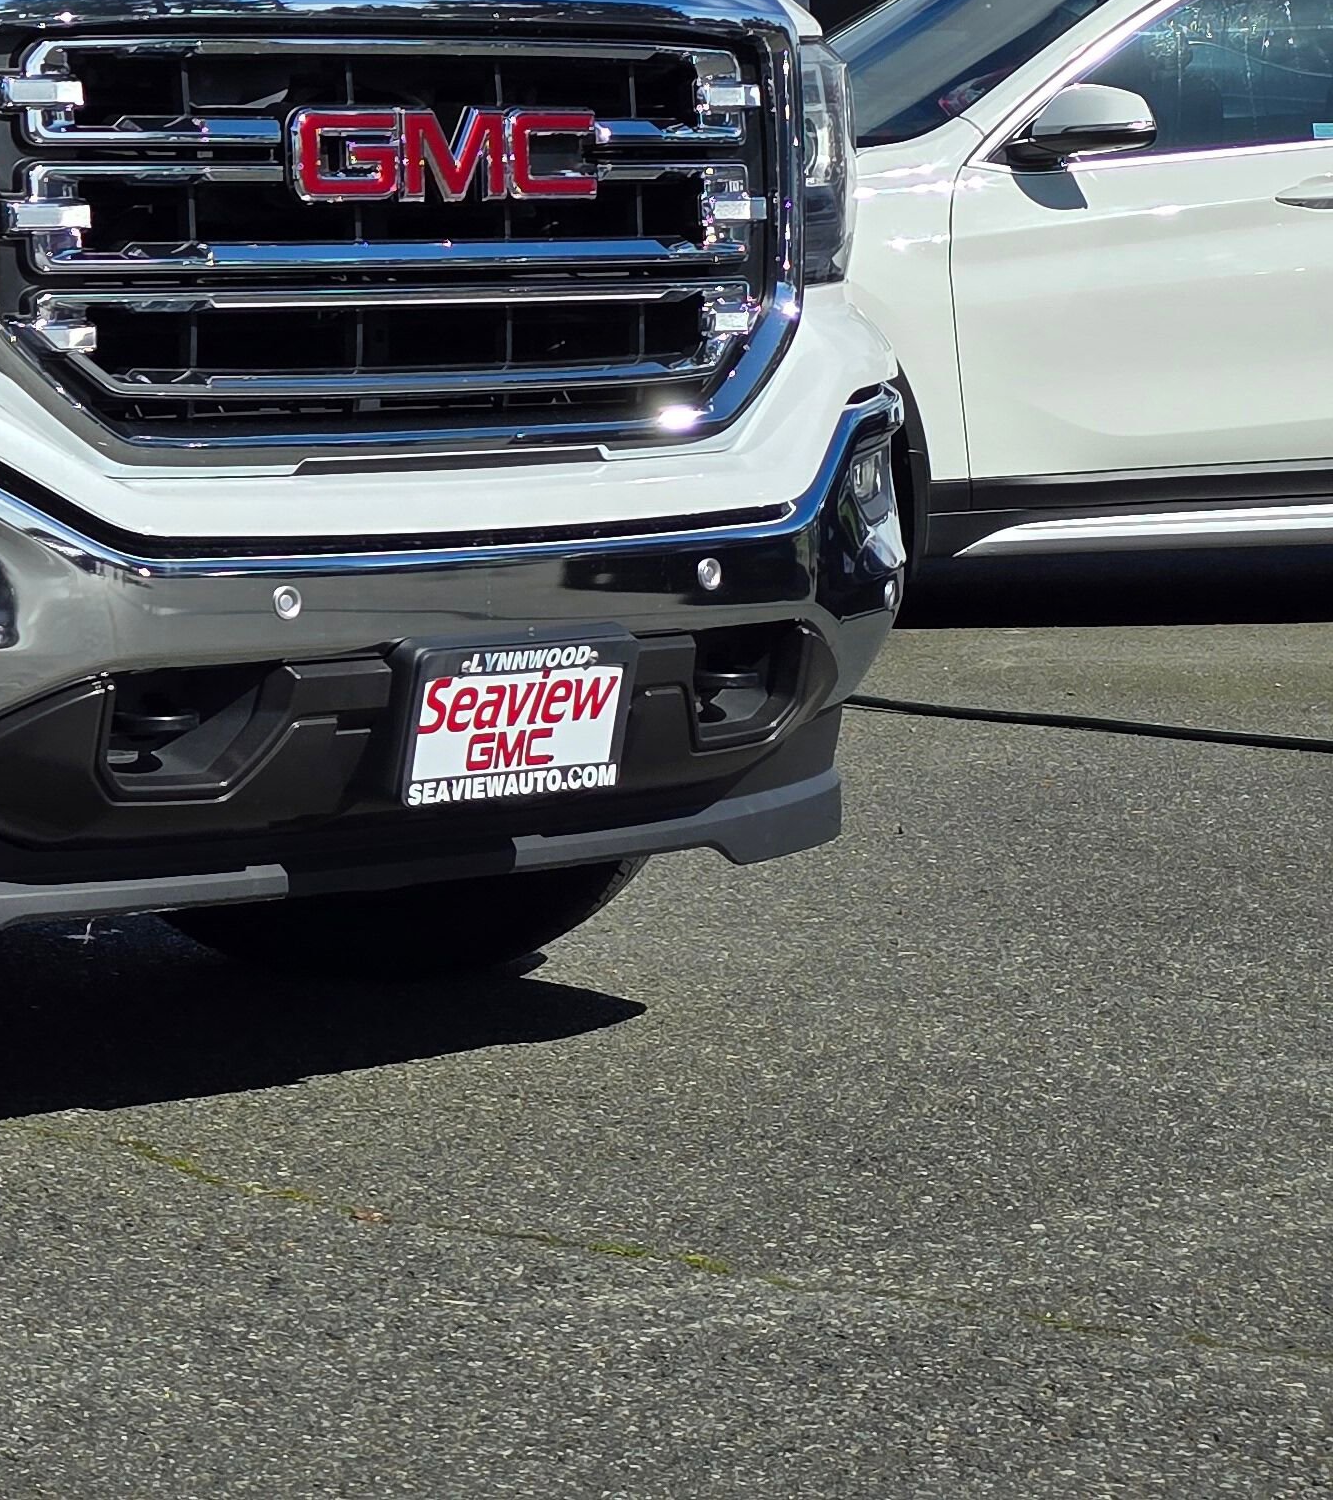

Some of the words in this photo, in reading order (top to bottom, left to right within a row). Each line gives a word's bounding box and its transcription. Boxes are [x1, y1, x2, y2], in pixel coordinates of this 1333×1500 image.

[286, 105, 597, 203] GMC
[470, 645, 593, 674] LYNNWOOD
[416, 668, 619, 735] Seaview
[465, 727, 554, 772] GMC
[407, 763, 617, 805] SEAVIEWAUTO.COM
